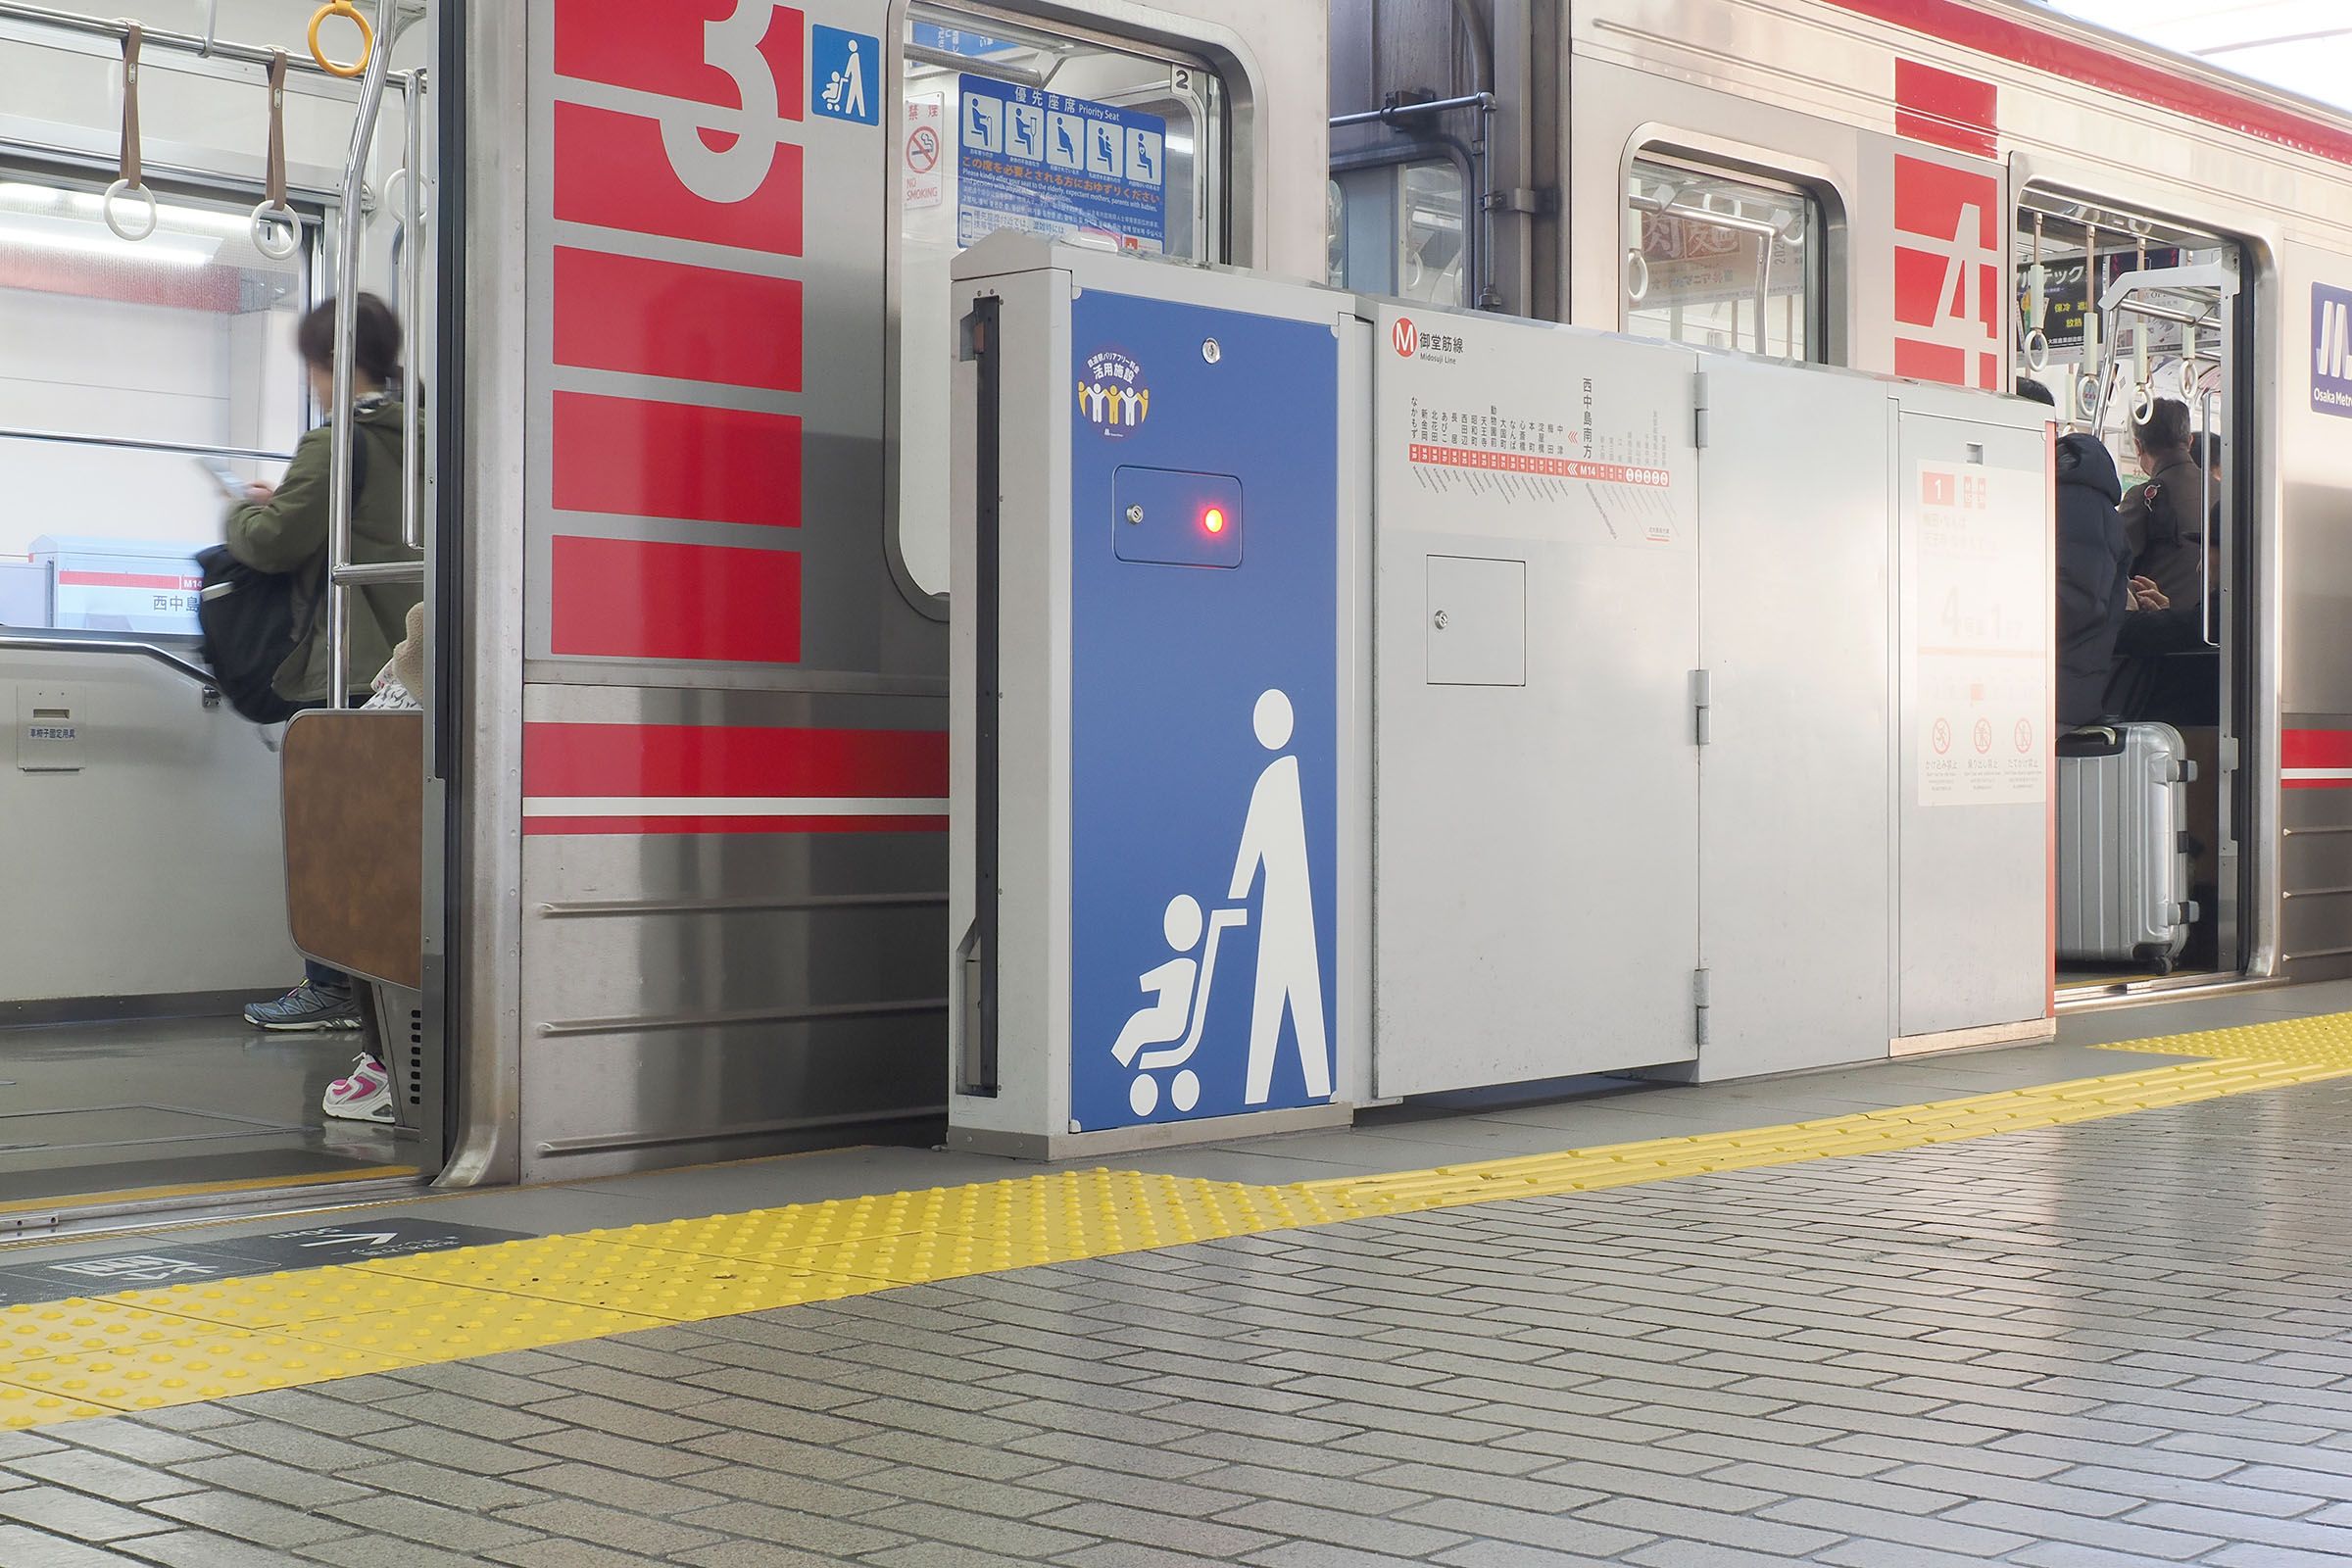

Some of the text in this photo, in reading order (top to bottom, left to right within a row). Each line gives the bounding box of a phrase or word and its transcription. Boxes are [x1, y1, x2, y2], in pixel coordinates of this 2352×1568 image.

[1175, 70, 1189, 90] 2
[658, 0, 779, 204] 3
[1014, 86, 1120, 122] 優先座席 Priority Seat
[906, 177, 917, 189] NO
[962, 156, 1160, 204] この席を必要とされる方におゆずりください
[906, 186, 938, 201] SMOKING
[1932, 202, 1988, 386] 4
[1419, 332, 1463, 354] 御堂筋線
[1420, 352, 1456, 365] Midosuji Line
[1092, 362, 1135, 384] 活用施設
[2313, 387, 2335, 401] Osaka
[1583, 377, 1592, 460] 西中島南方
[1580, 465, 1596, 477] M14
[1934, 478, 1942, 502] 1
[183, 578, 203, 588] M14
